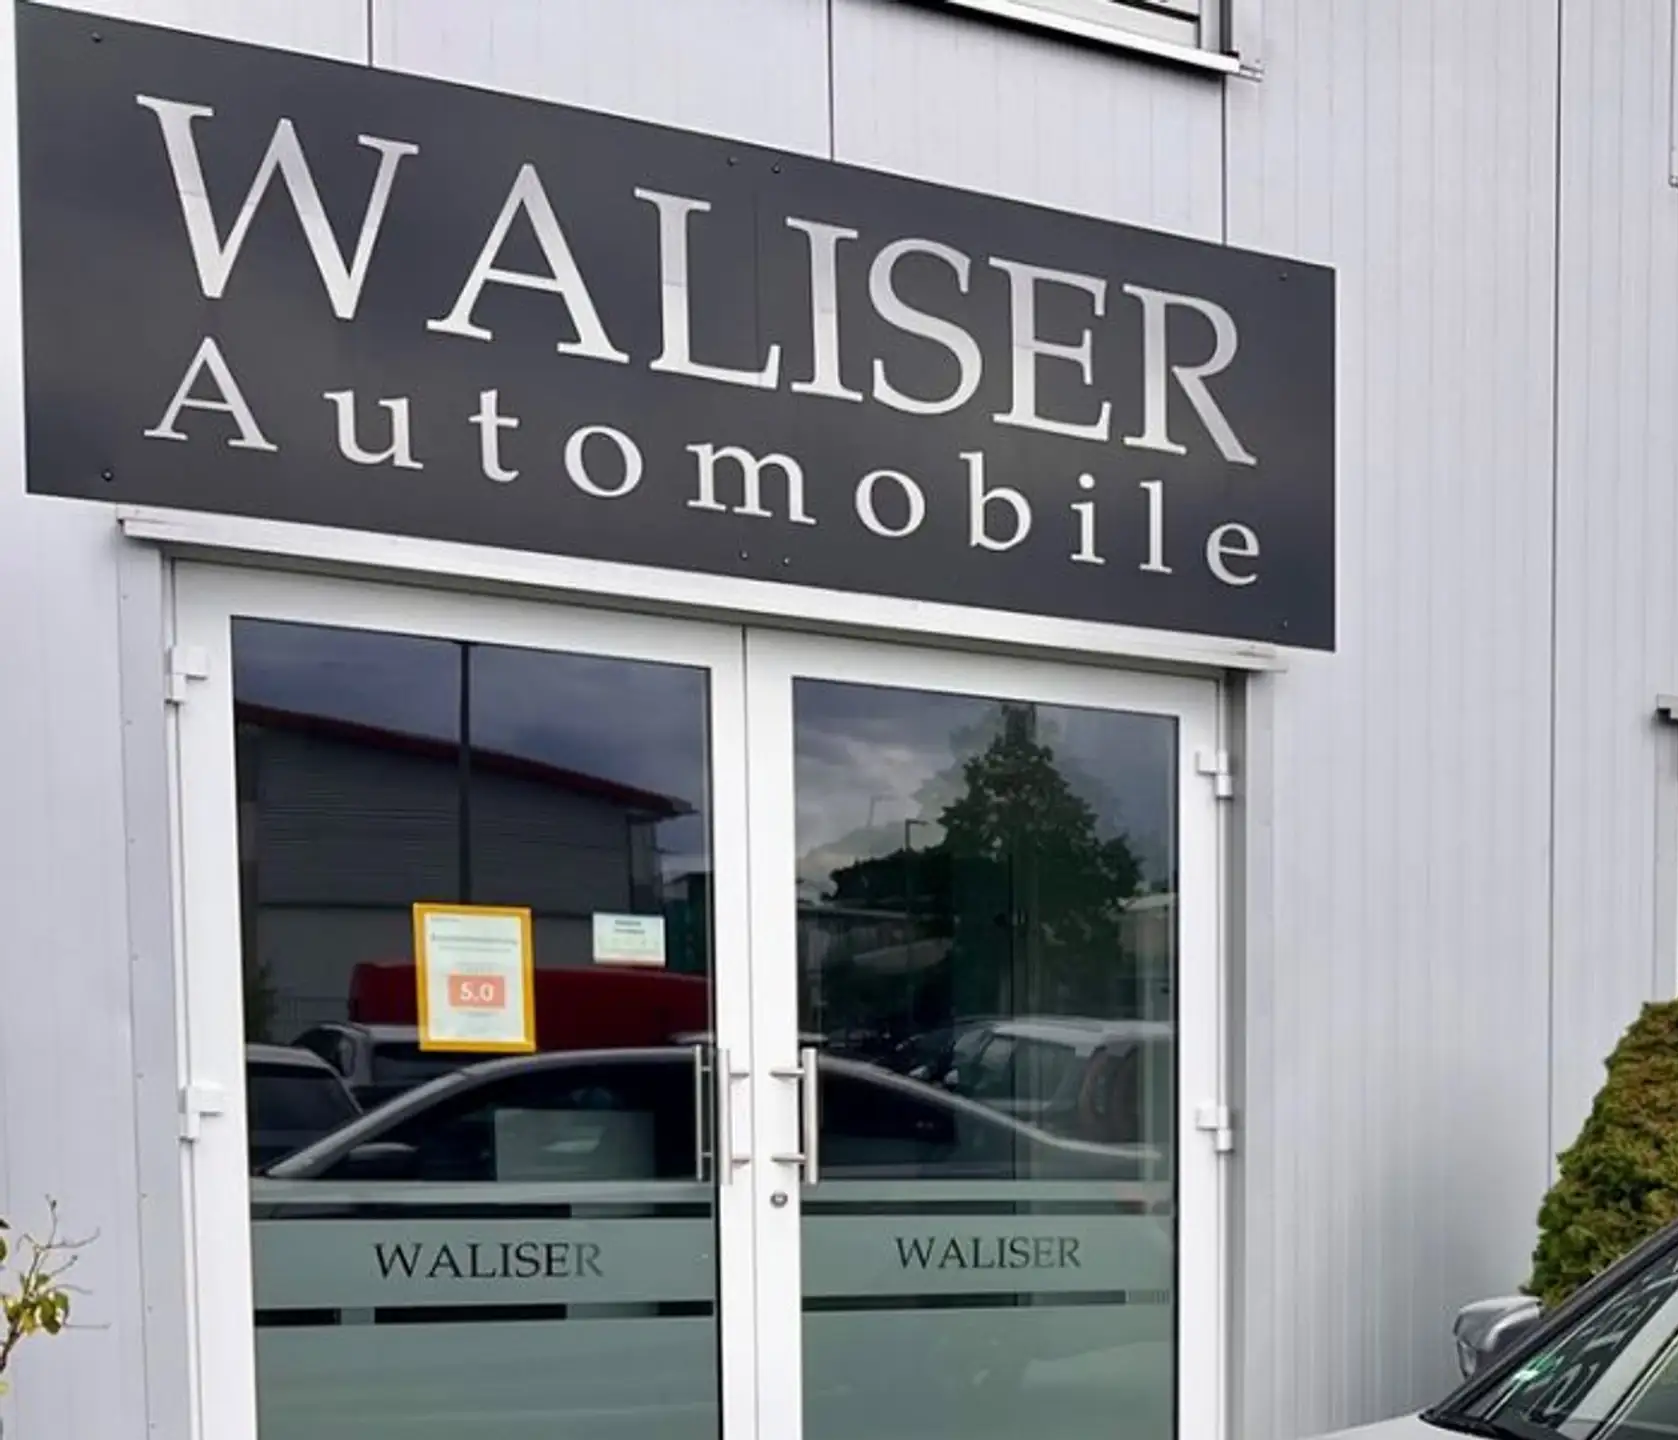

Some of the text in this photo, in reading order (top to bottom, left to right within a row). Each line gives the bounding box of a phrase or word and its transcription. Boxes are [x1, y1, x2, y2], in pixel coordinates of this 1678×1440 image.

[136, 93, 1256, 467] WALISER
[143, 335, 1262, 587] Automobile
[373, 1241, 604, 1280] WALISER
[895, 1236, 1082, 1270] WALISER
